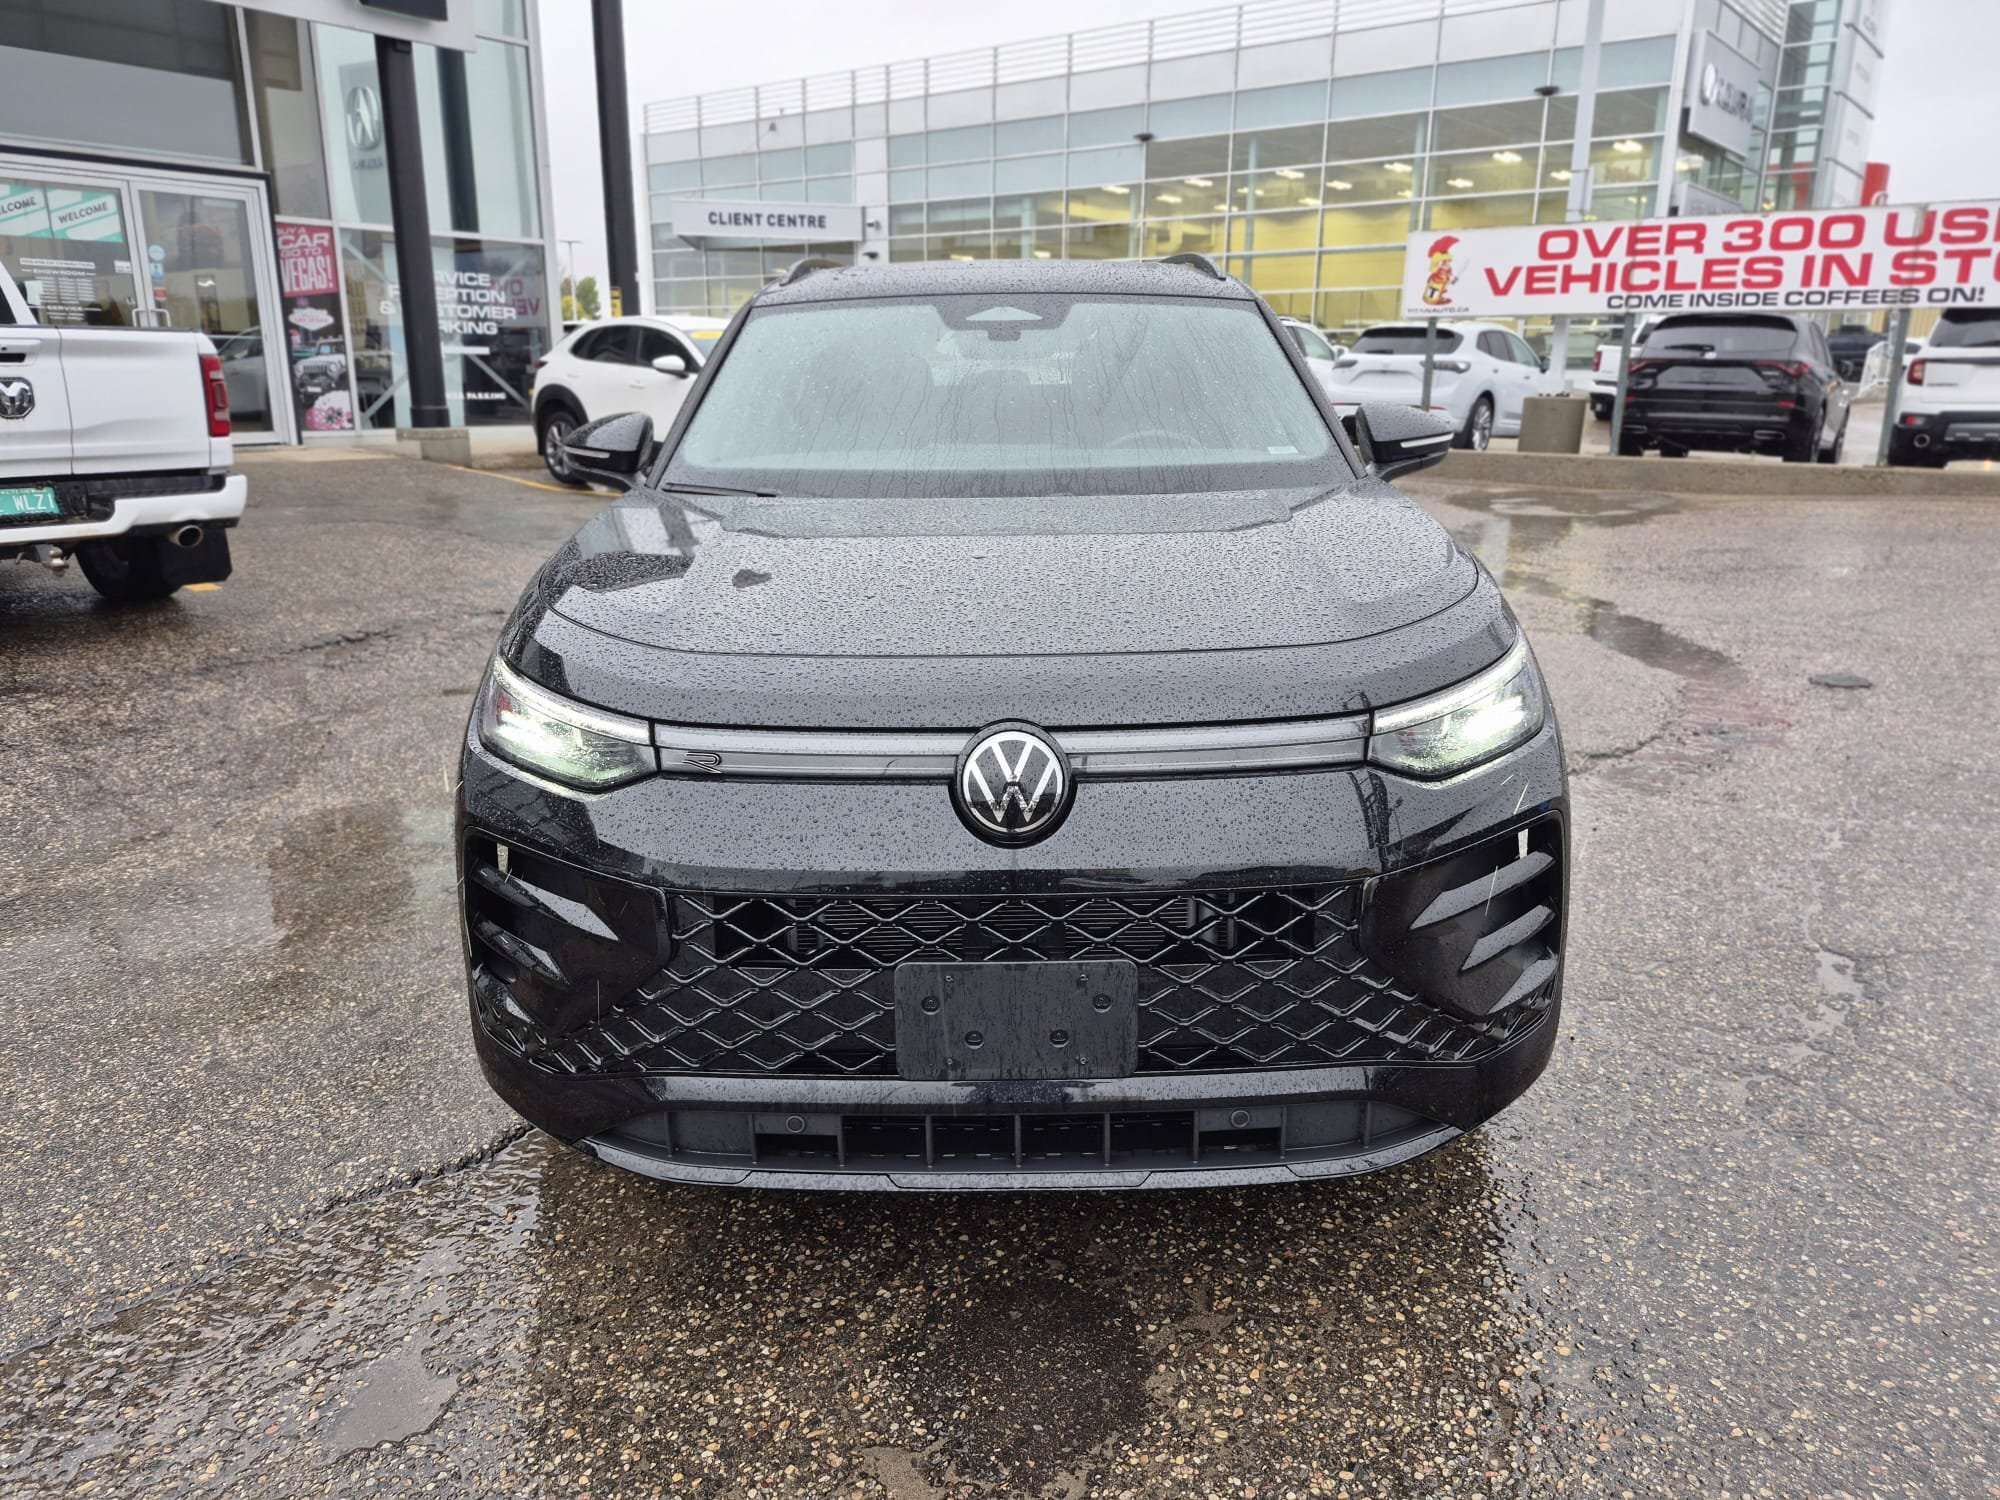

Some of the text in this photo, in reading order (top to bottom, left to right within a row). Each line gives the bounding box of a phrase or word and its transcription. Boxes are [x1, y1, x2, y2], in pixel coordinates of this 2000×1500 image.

[0, 196, 37, 216] LCOME
[57, 201, 108, 224] WELCOME
[708, 211, 827, 229] CLIENT CENTRE
[278, 232, 330, 250] CAR
[1538, 222, 1707, 261] OVER
[1722, 214, 1866, 253] 300
[280, 246, 322, 258] GO TO
[280, 254, 334, 292] VEGAS!
[434, 271, 492, 287] RVICE
[1484, 248, 2000, 296] VEHICLES IN ST
[379, 300, 397, 315] &
[1606, 287, 1986, 309] COME INSIDE COFFEES ON!
[438, 319, 498, 336] RKING
